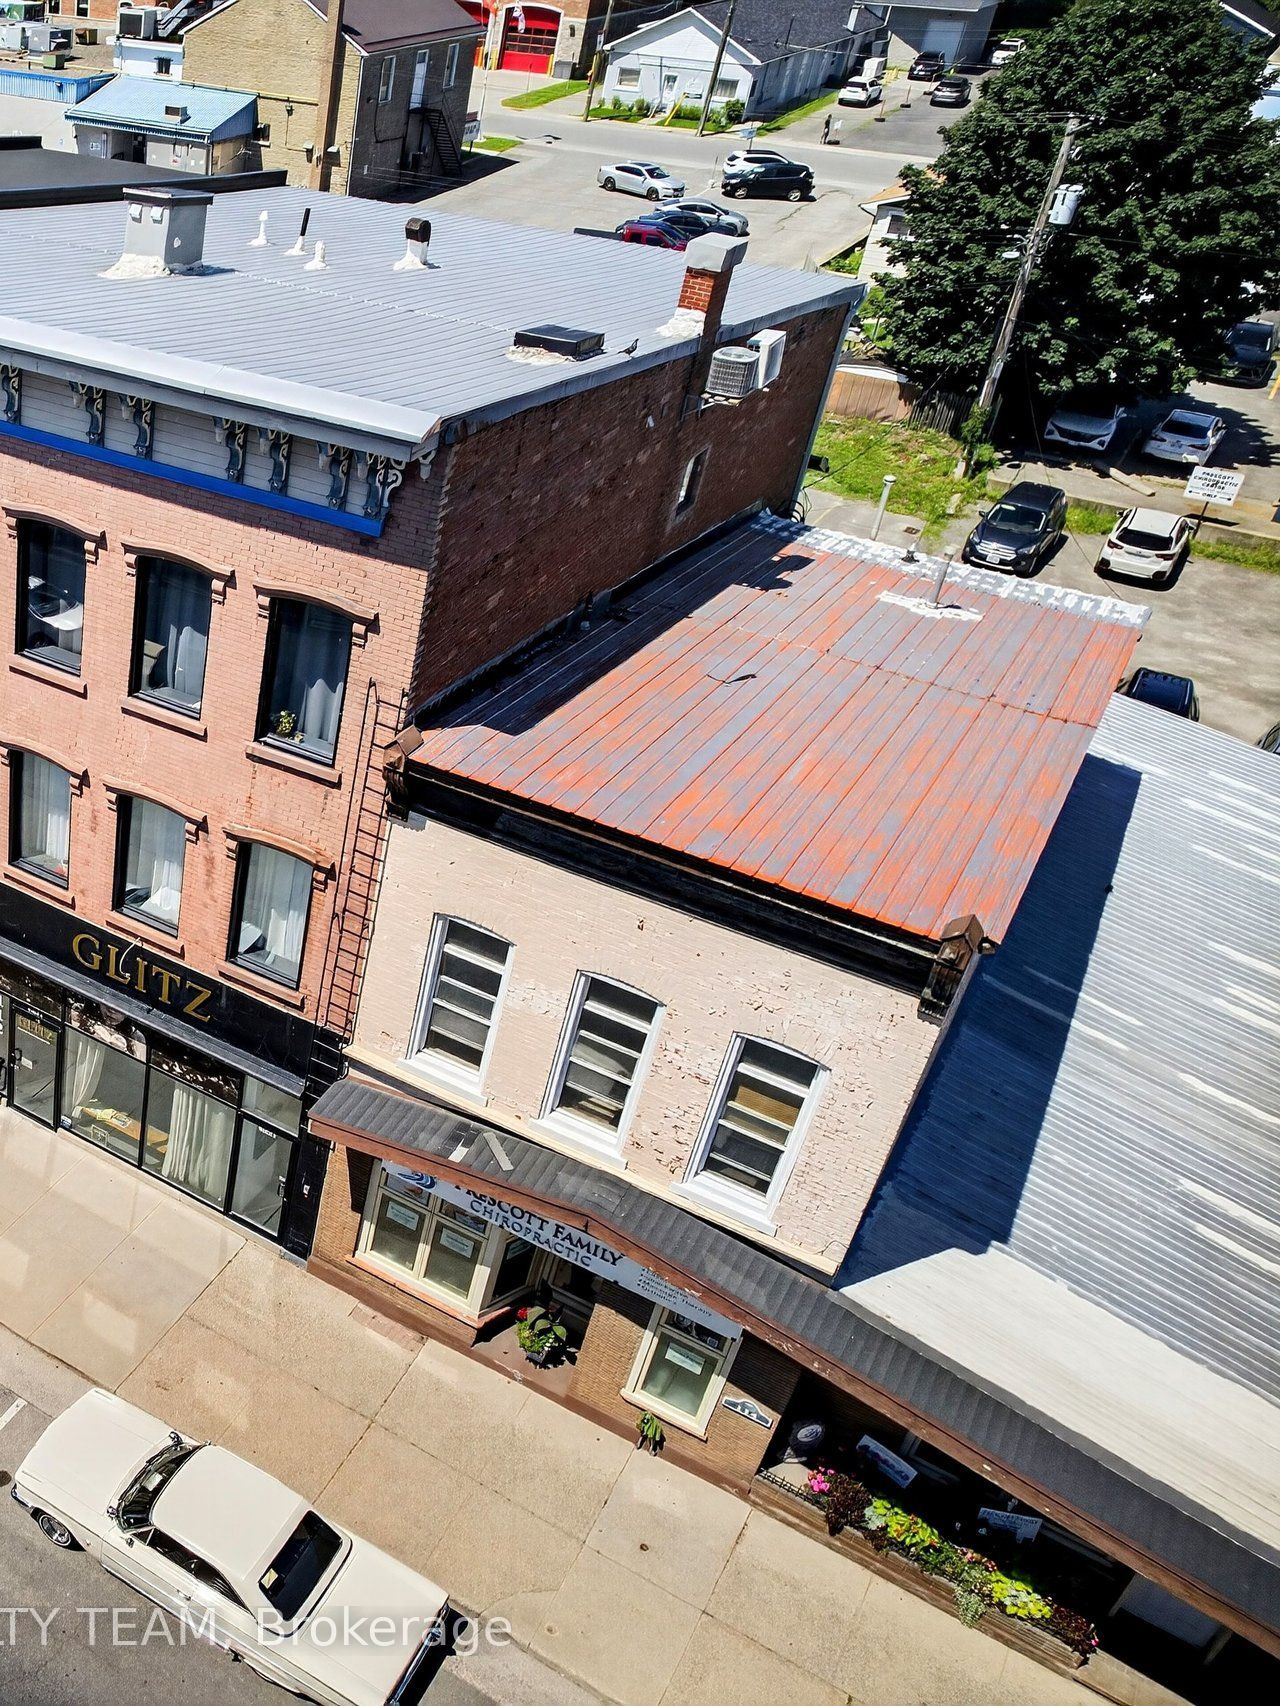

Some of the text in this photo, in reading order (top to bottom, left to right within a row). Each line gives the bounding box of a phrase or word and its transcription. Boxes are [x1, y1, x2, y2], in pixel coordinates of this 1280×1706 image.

[72, 933, 212, 1022] GLITZ
[455, 1185, 549, 1231] RESCOTT
[553, 1223, 625, 1267] FAMILY
[470, 1201, 592, 1267] CHIROPRACTIC
